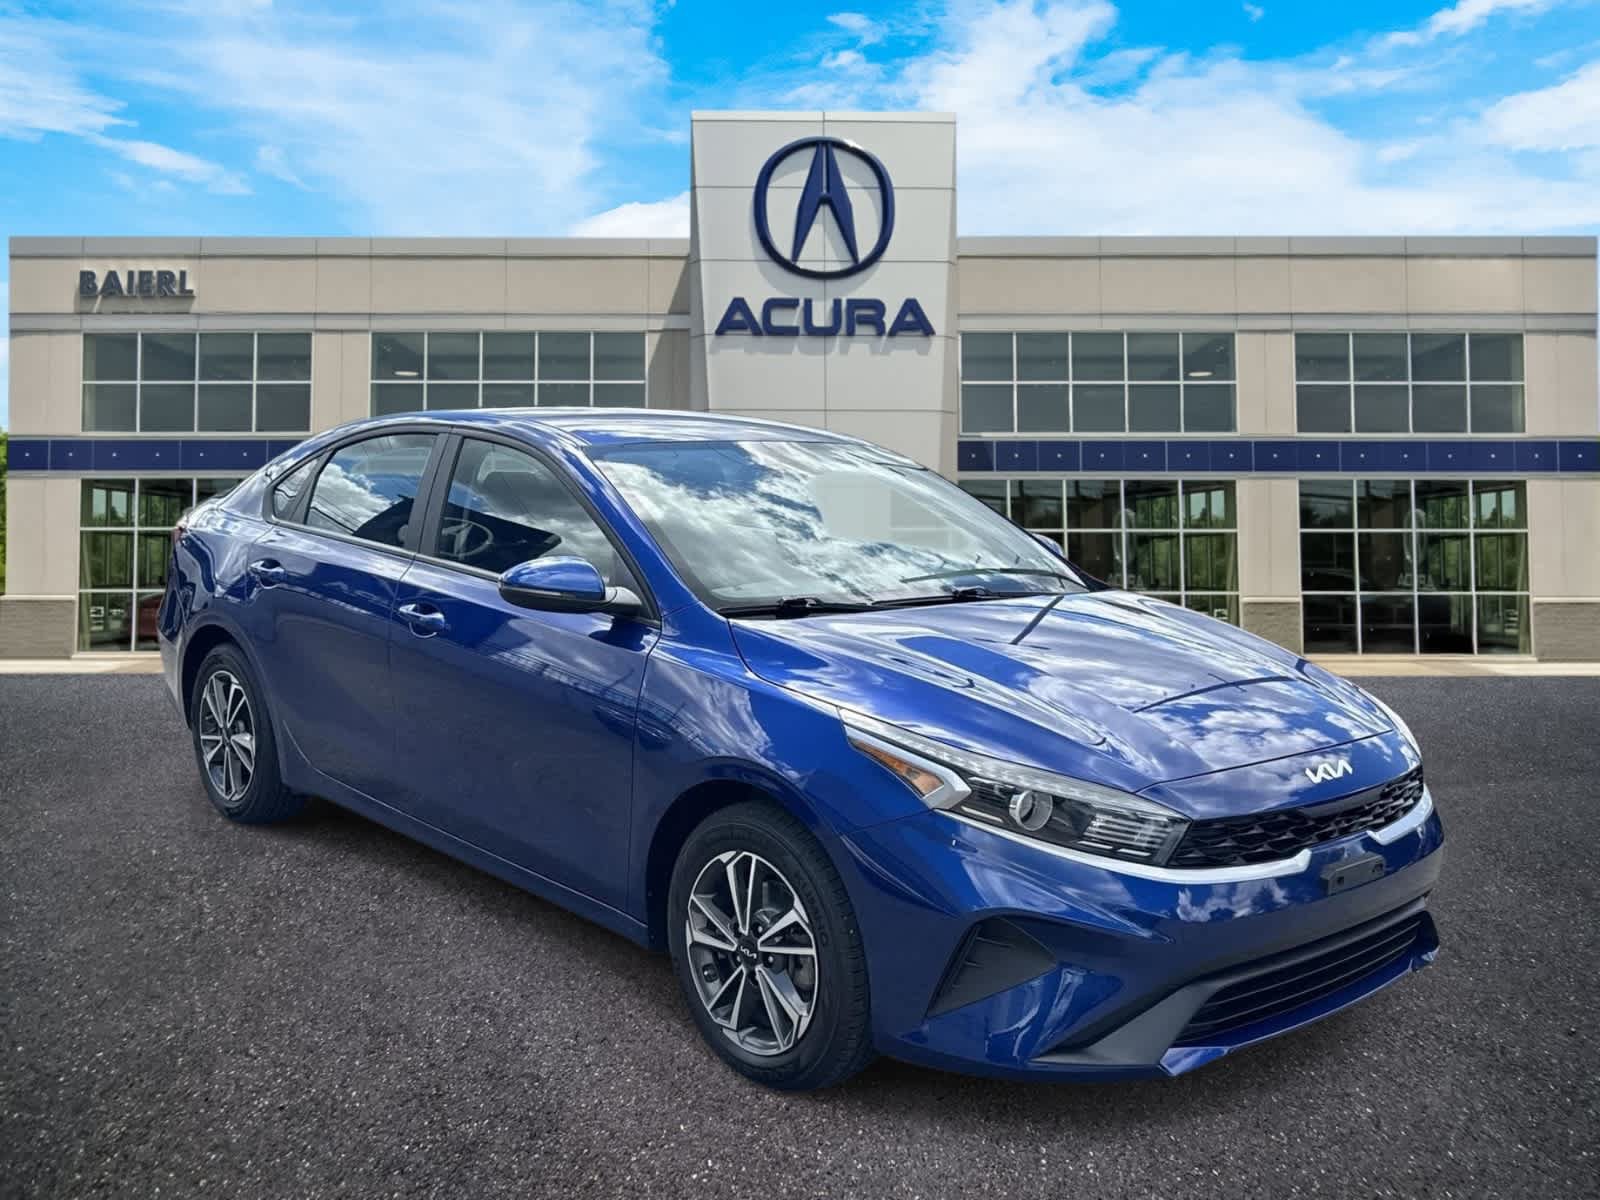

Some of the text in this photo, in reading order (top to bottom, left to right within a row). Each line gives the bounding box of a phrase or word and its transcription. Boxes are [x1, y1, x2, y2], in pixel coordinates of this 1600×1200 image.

[79, 269, 195, 296] BAIERL
[715, 297, 936, 336] ACURA
[1305, 759, 1353, 784] KIA
